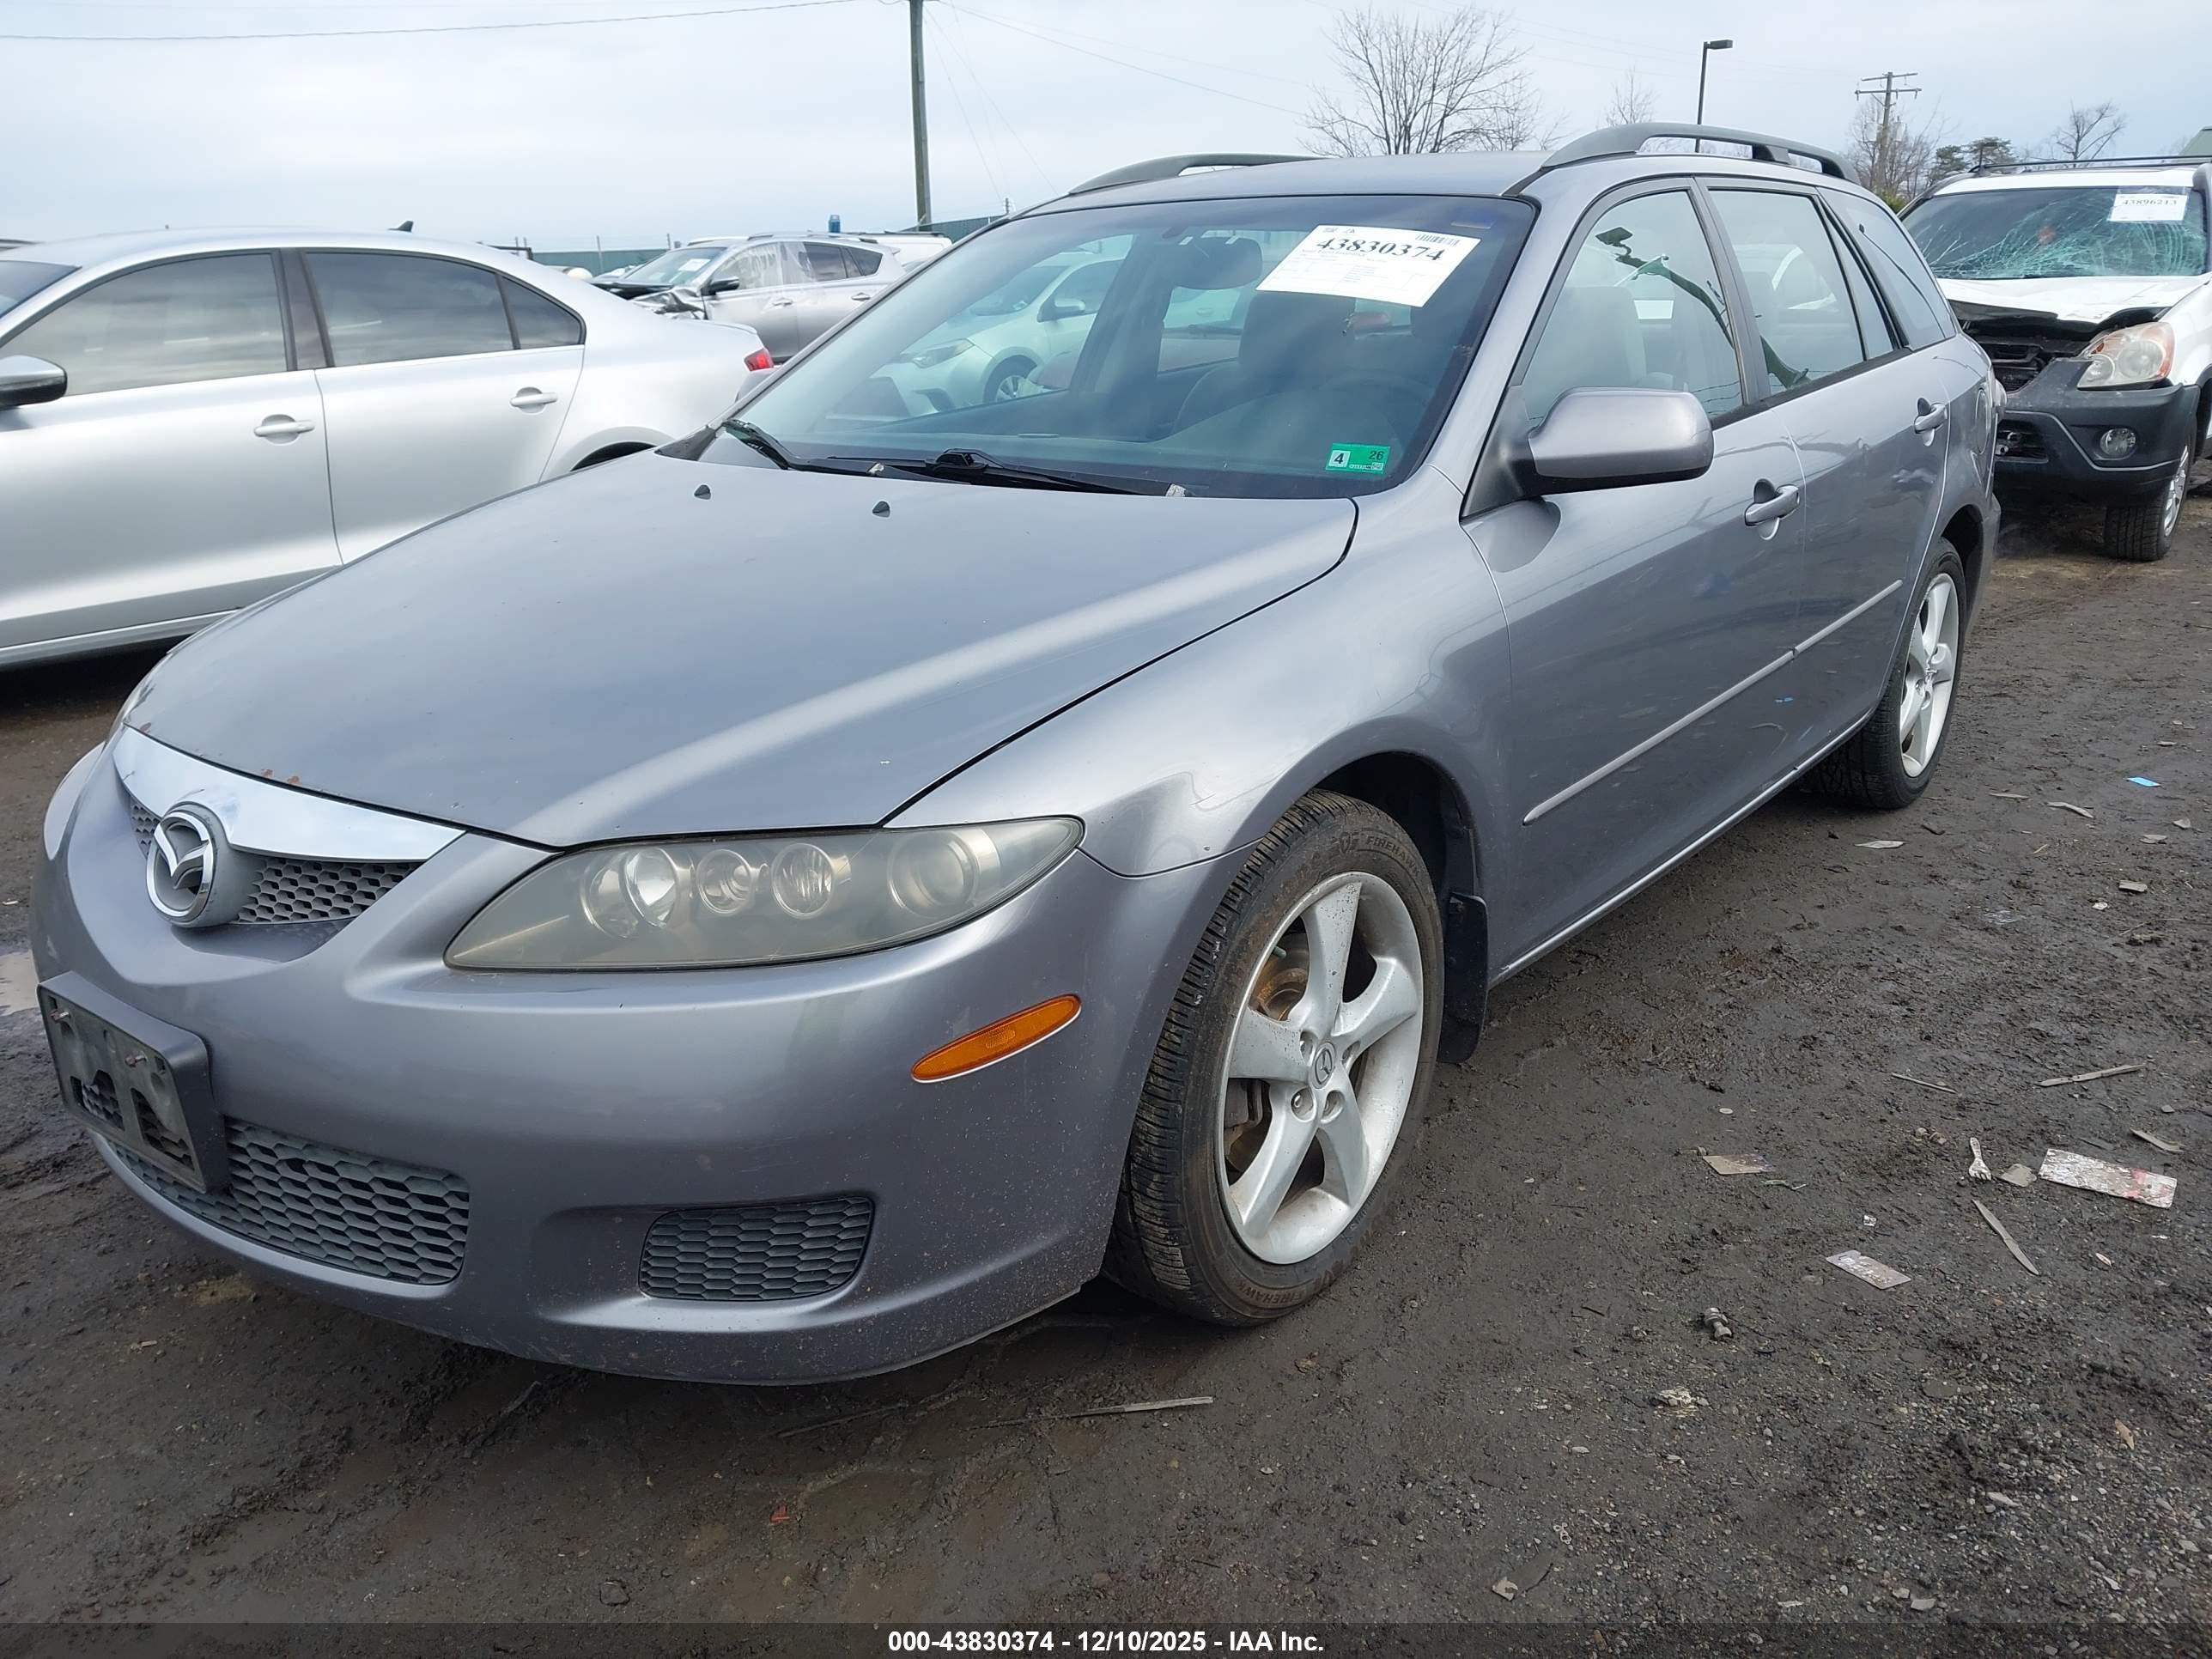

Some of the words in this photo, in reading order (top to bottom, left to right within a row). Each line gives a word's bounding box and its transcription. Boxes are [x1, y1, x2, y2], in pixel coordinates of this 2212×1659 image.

[1317, 238, 1445, 260] 43830374
[1334, 453, 1344, 464] 4
[1369, 451, 1384, 460] 26
